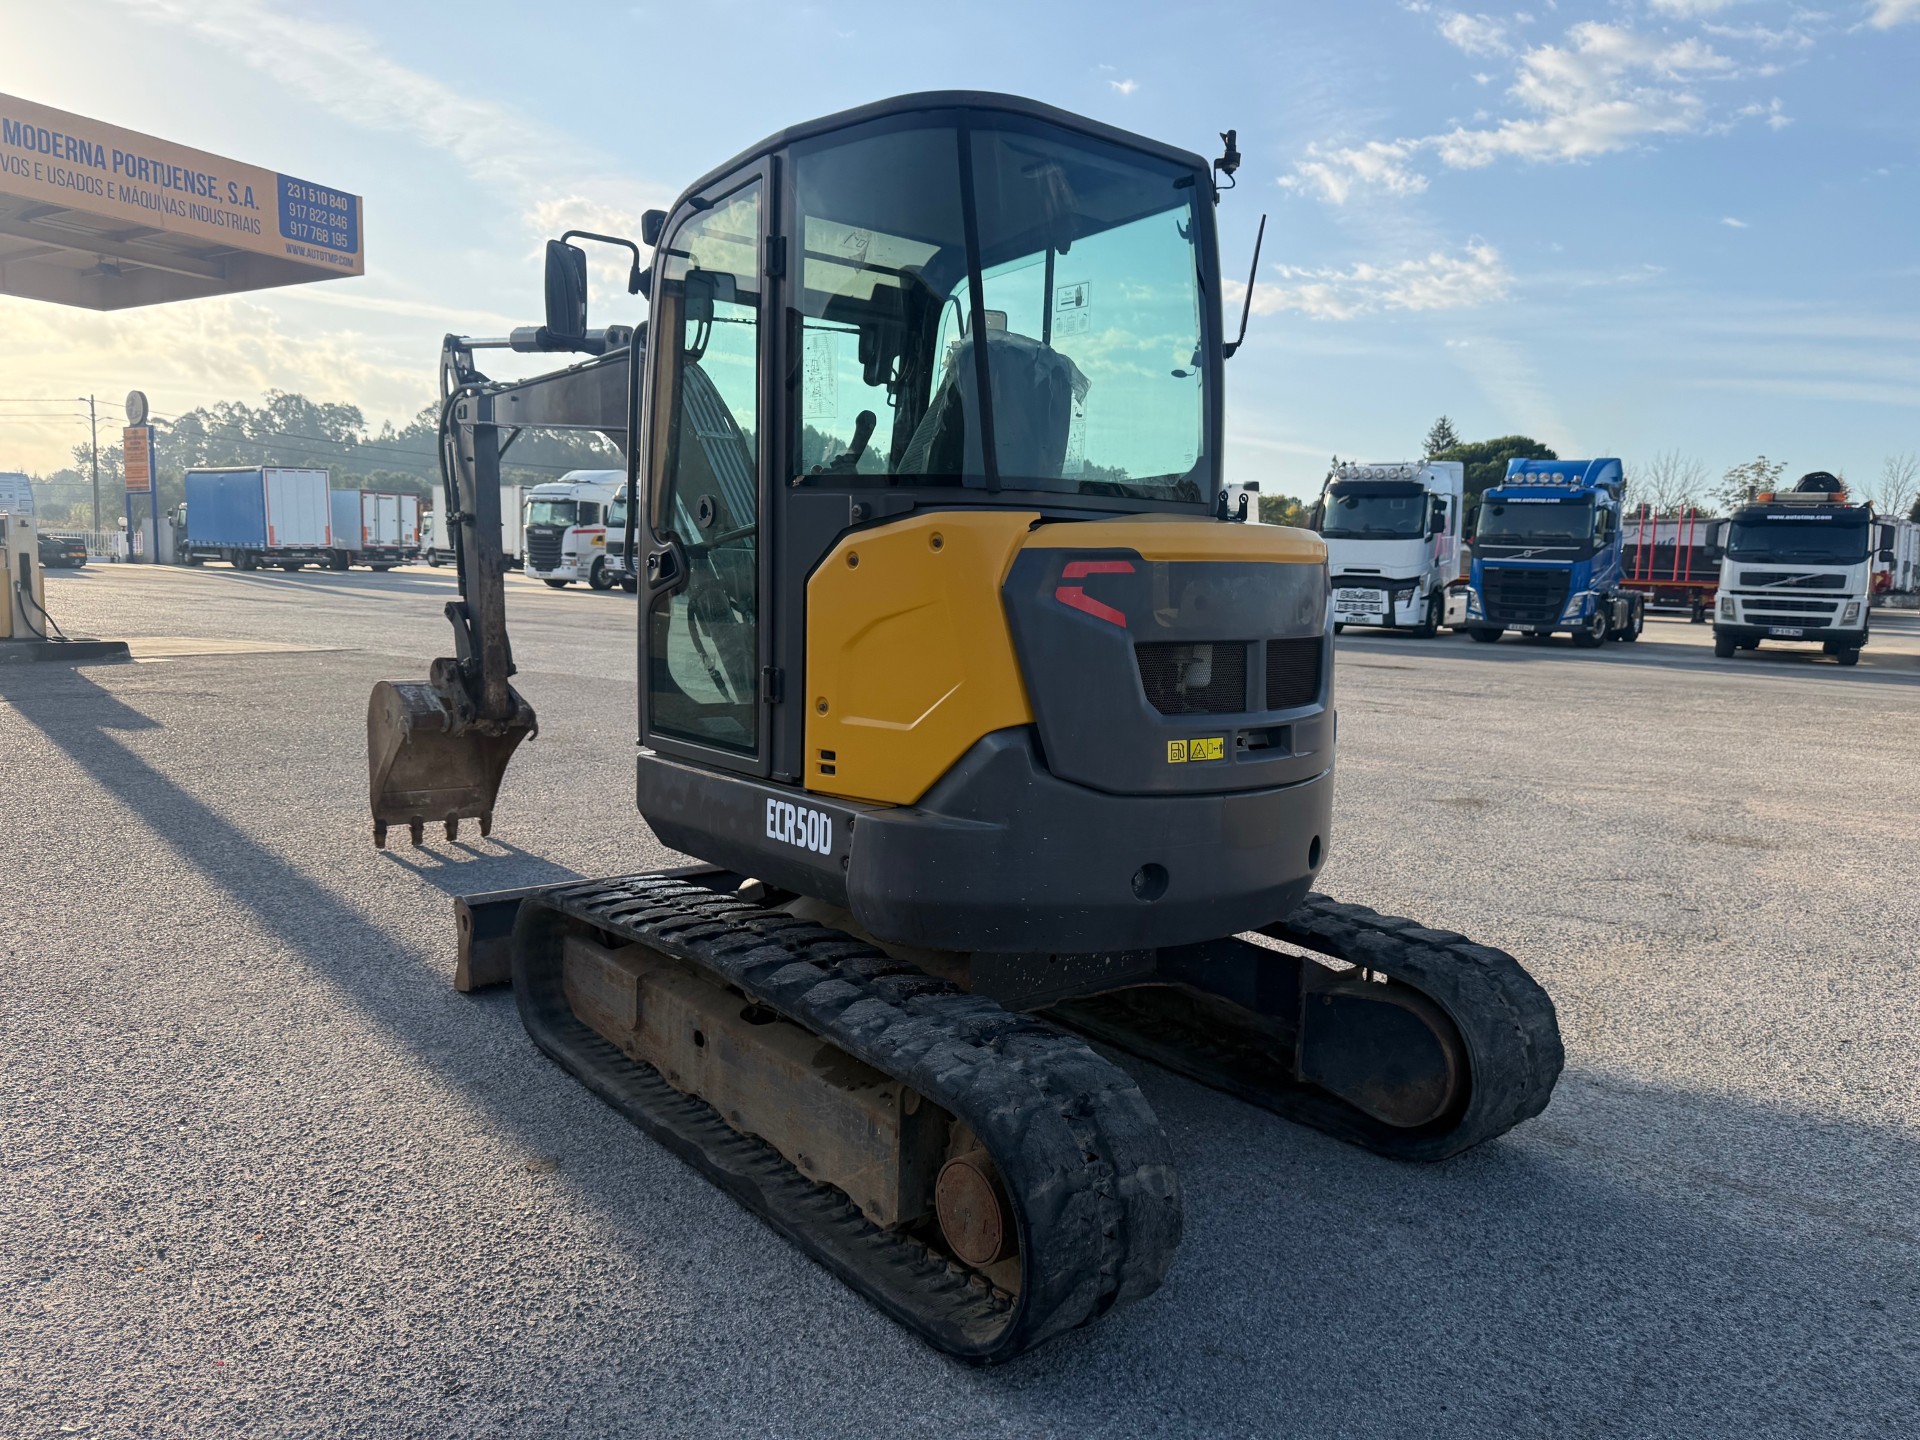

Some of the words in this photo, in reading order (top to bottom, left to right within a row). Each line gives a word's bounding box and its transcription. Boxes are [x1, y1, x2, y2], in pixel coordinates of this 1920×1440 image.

[2, 117, 107, 171] MODERNA
[112, 148, 223, 204] PORTUENSE,
[227, 181, 260, 210] S.A.
[34, 162, 43, 181] E
[47, 165, 104, 196] USADOS
[107, 181, 115, 200] E
[119, 185, 186, 217] MÁQUINAS
[189, 202, 262, 235] INDUSTRIAIS
[287, 182, 306, 200] 231
[309, 188, 328, 206] 510
[329, 194, 348, 211] 840
[289, 202, 307, 219] 917
[309, 207, 328, 225] 822
[329, 213, 348, 230] 846
[290, 221, 308, 238] 917
[310, 225, 329, 243] 768
[332, 231, 348, 248] 195
[285, 243, 354, 268] WWW.AUTOTMP.COM
[1766, 513, 1832, 521] www.autotmp.com
[766, 797, 832, 856] ECR50D
